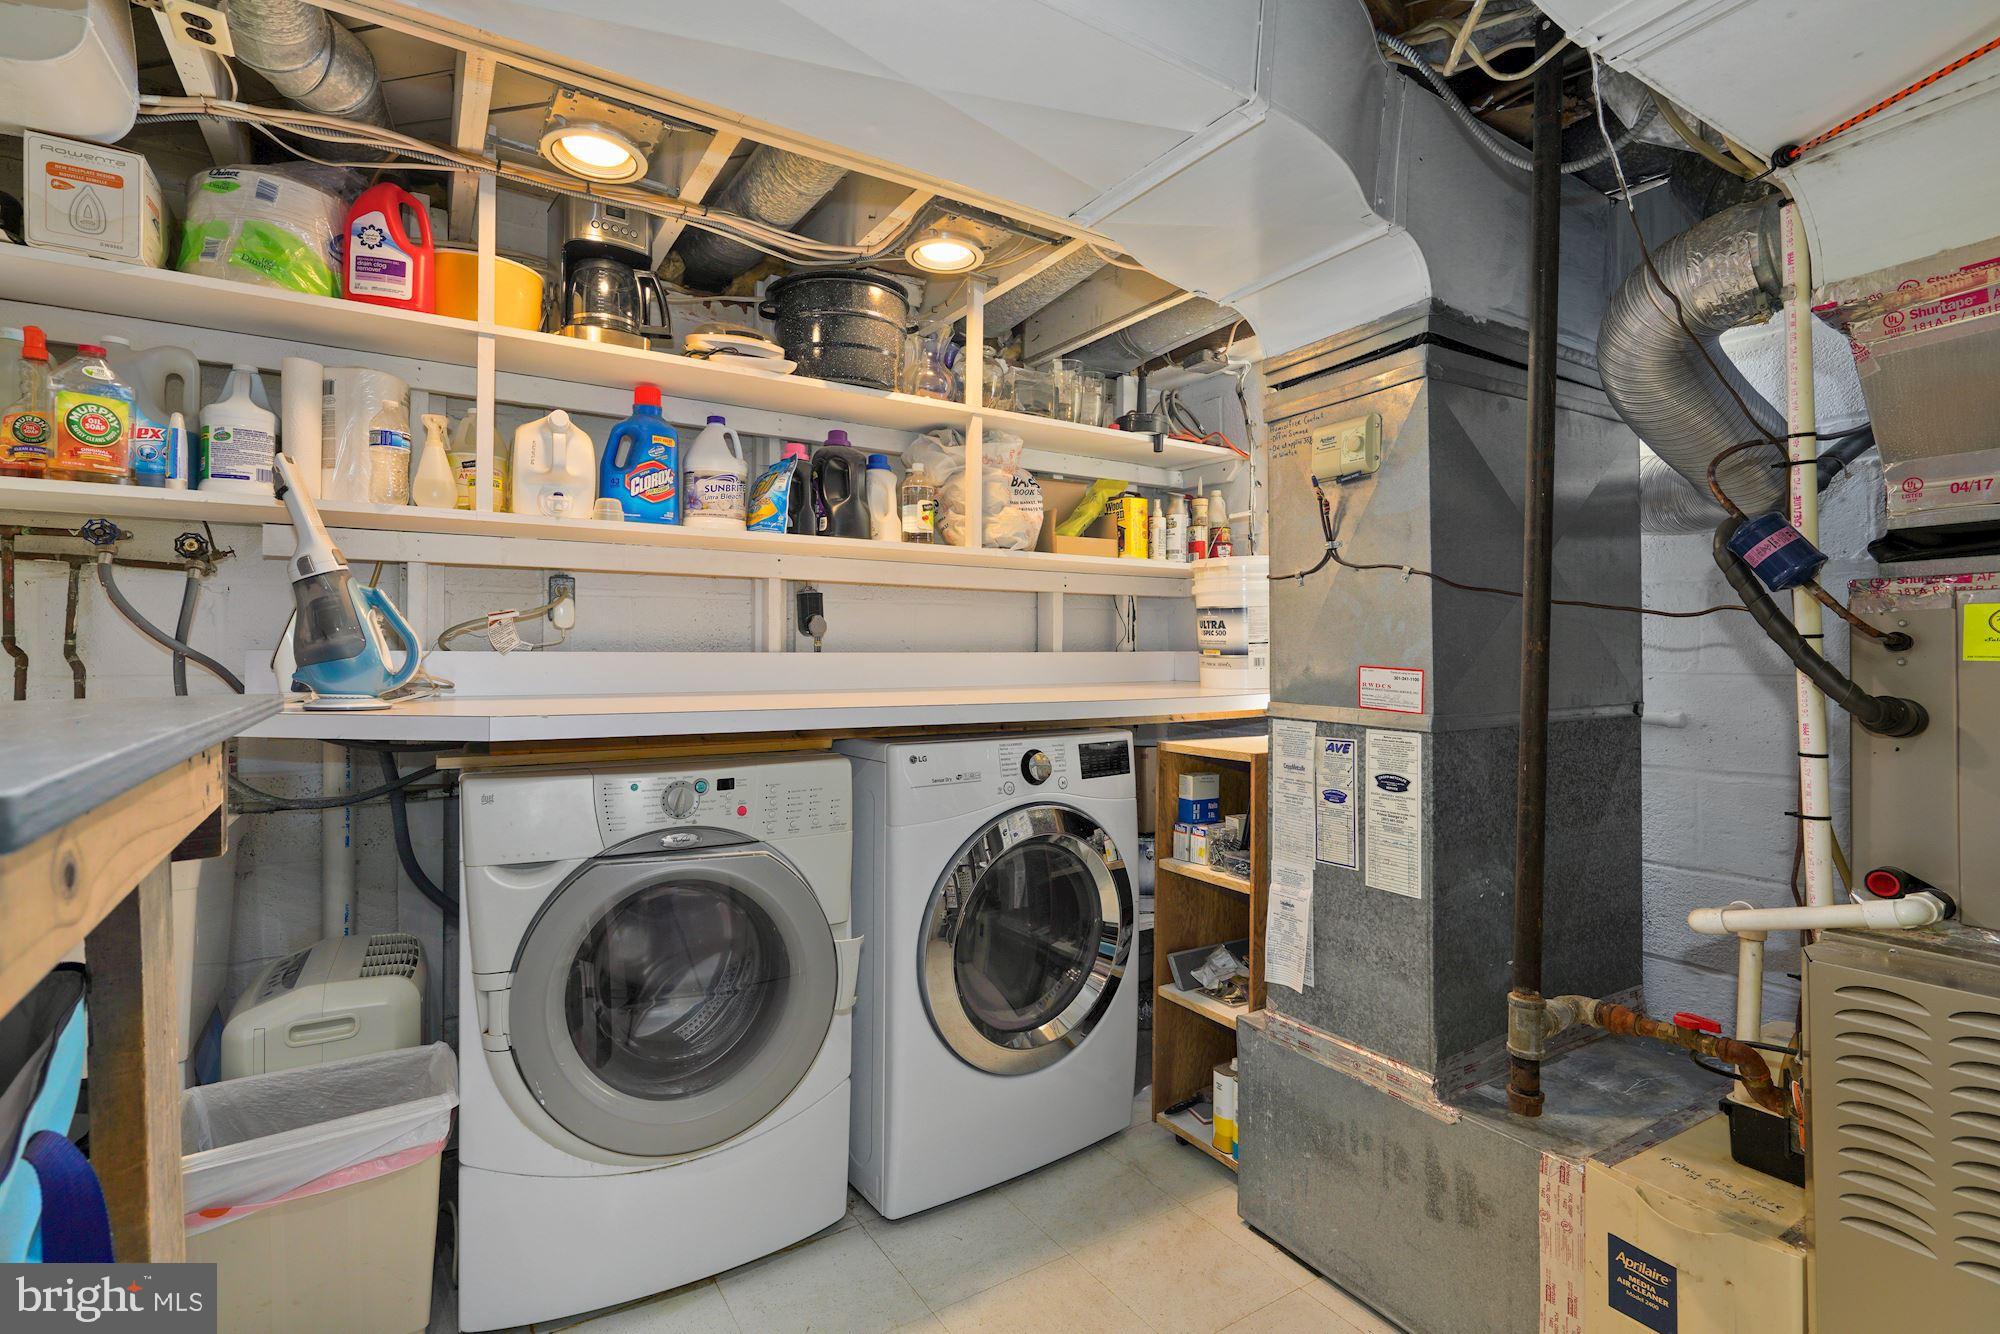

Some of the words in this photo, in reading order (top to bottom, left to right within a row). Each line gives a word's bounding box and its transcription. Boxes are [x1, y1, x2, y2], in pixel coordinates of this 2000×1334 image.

[356, 265, 381, 273] remover
[373, 261, 387, 270] clog
[1909, 296, 1974, 320] Shurtape
[69, 405, 119, 429] MURPHY
[87, 418, 102, 426] OIL
[85, 423, 106, 431] SOAP
[1950, 478, 1994, 494] 04/17
[1105, 500, 1123, 513] Wood
[1199, 620, 1227, 629] ULTRA
[1325, 741, 1351, 754] AVE
[1615, 1251, 1670, 1286] Aprilaire
[1628, 1274, 1657, 1294] MEDIA
[1616, 1276, 1631, 1288] AIR
[1631, 1284, 1670, 1308] CLEANER
[1626, 1290, 1645, 1304] Model
